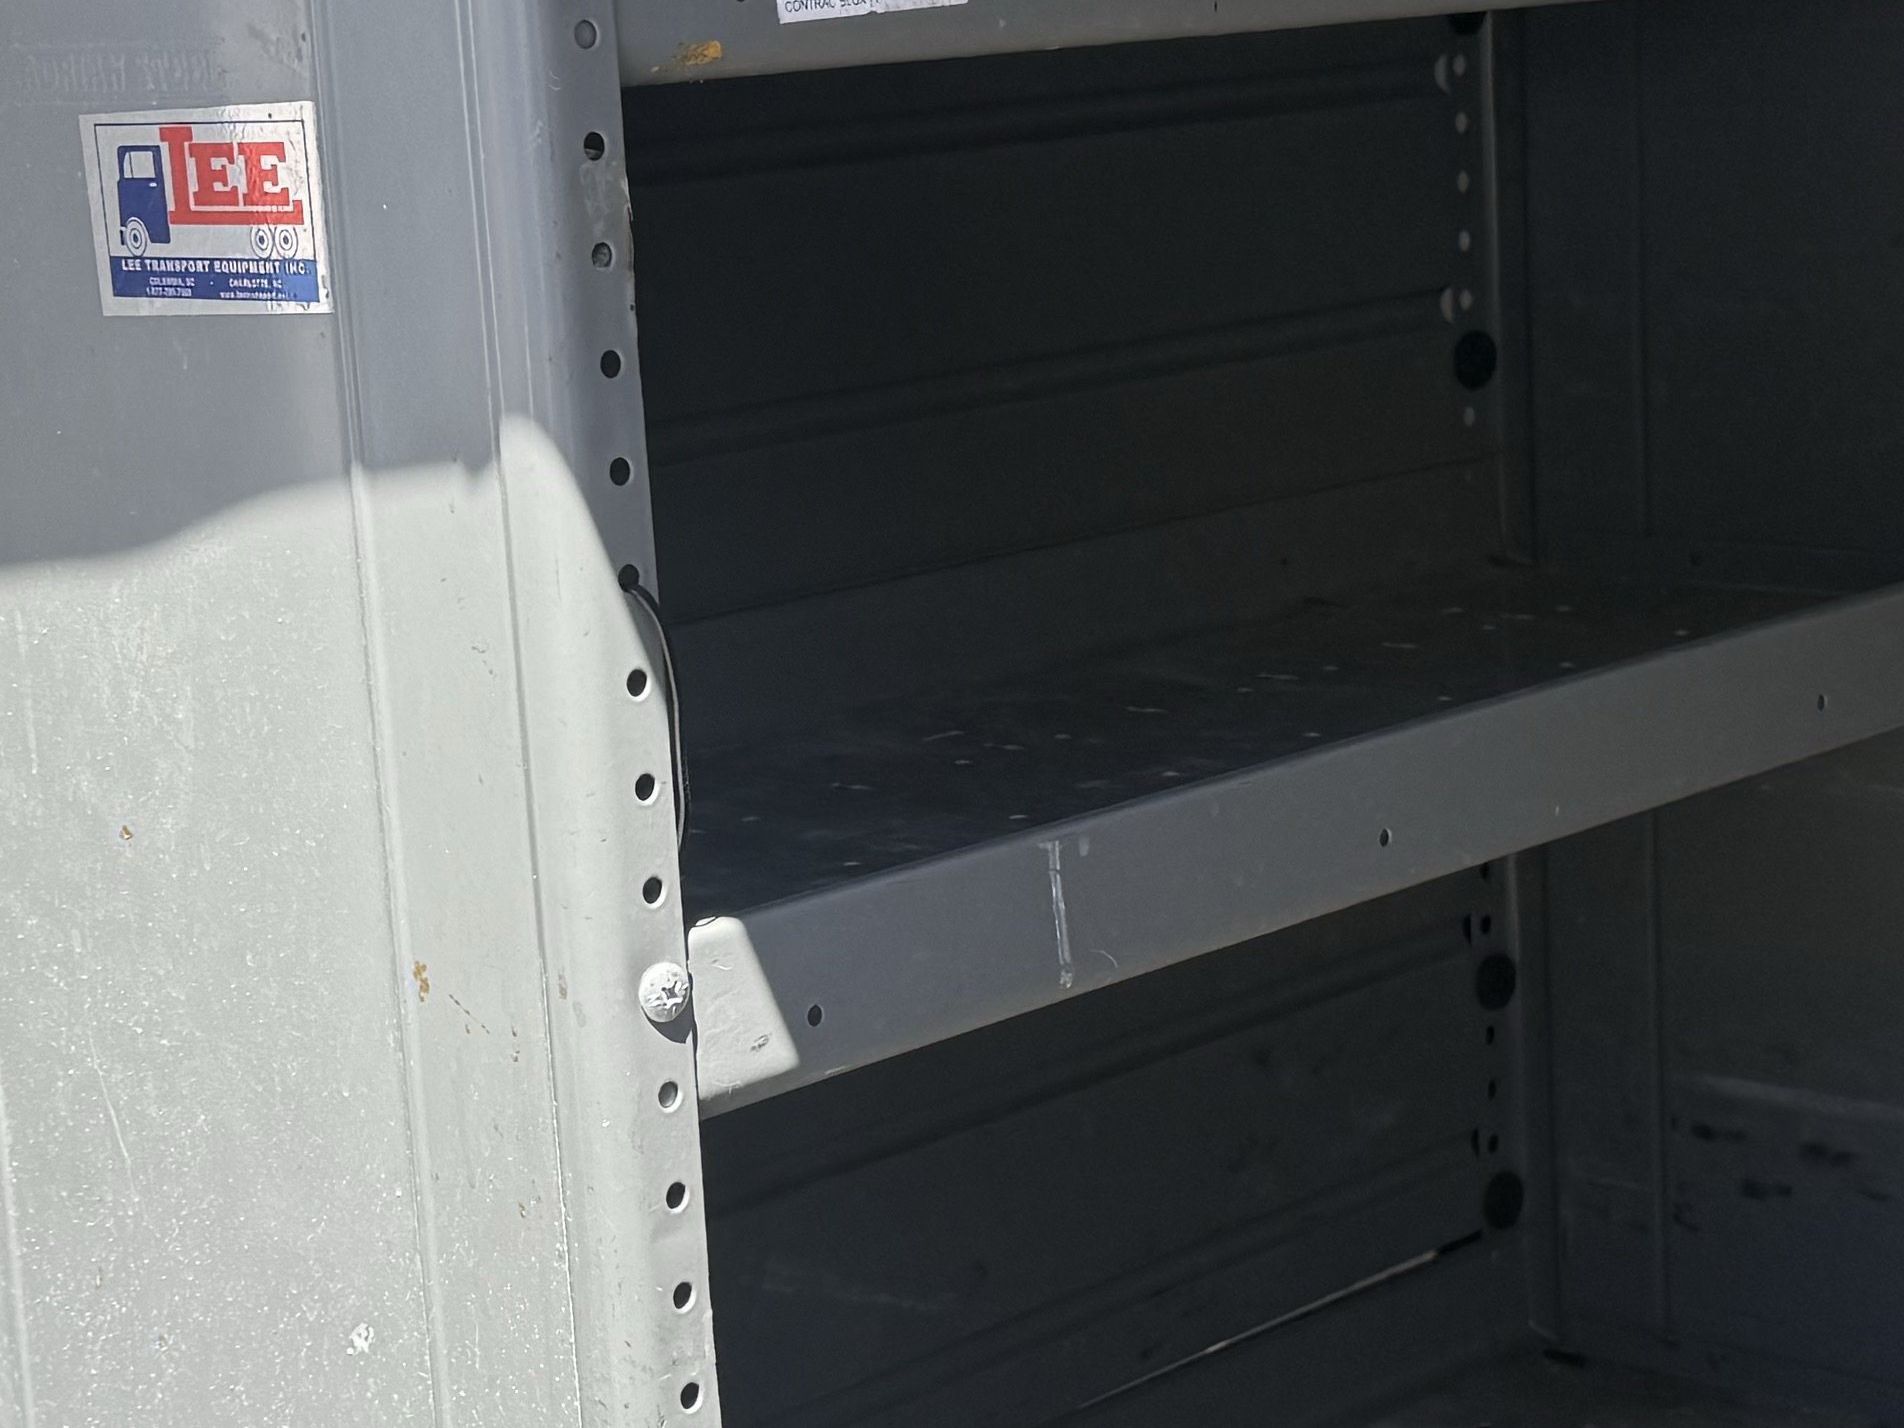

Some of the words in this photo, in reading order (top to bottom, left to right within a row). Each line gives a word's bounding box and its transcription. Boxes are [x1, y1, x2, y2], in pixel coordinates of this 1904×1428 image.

[159, 126, 304, 226] LEE
[122, 259, 142, 271] LEE
[144, 259, 210, 273] TRANSPORT
[213, 260, 280, 274] EQUIPMENT
